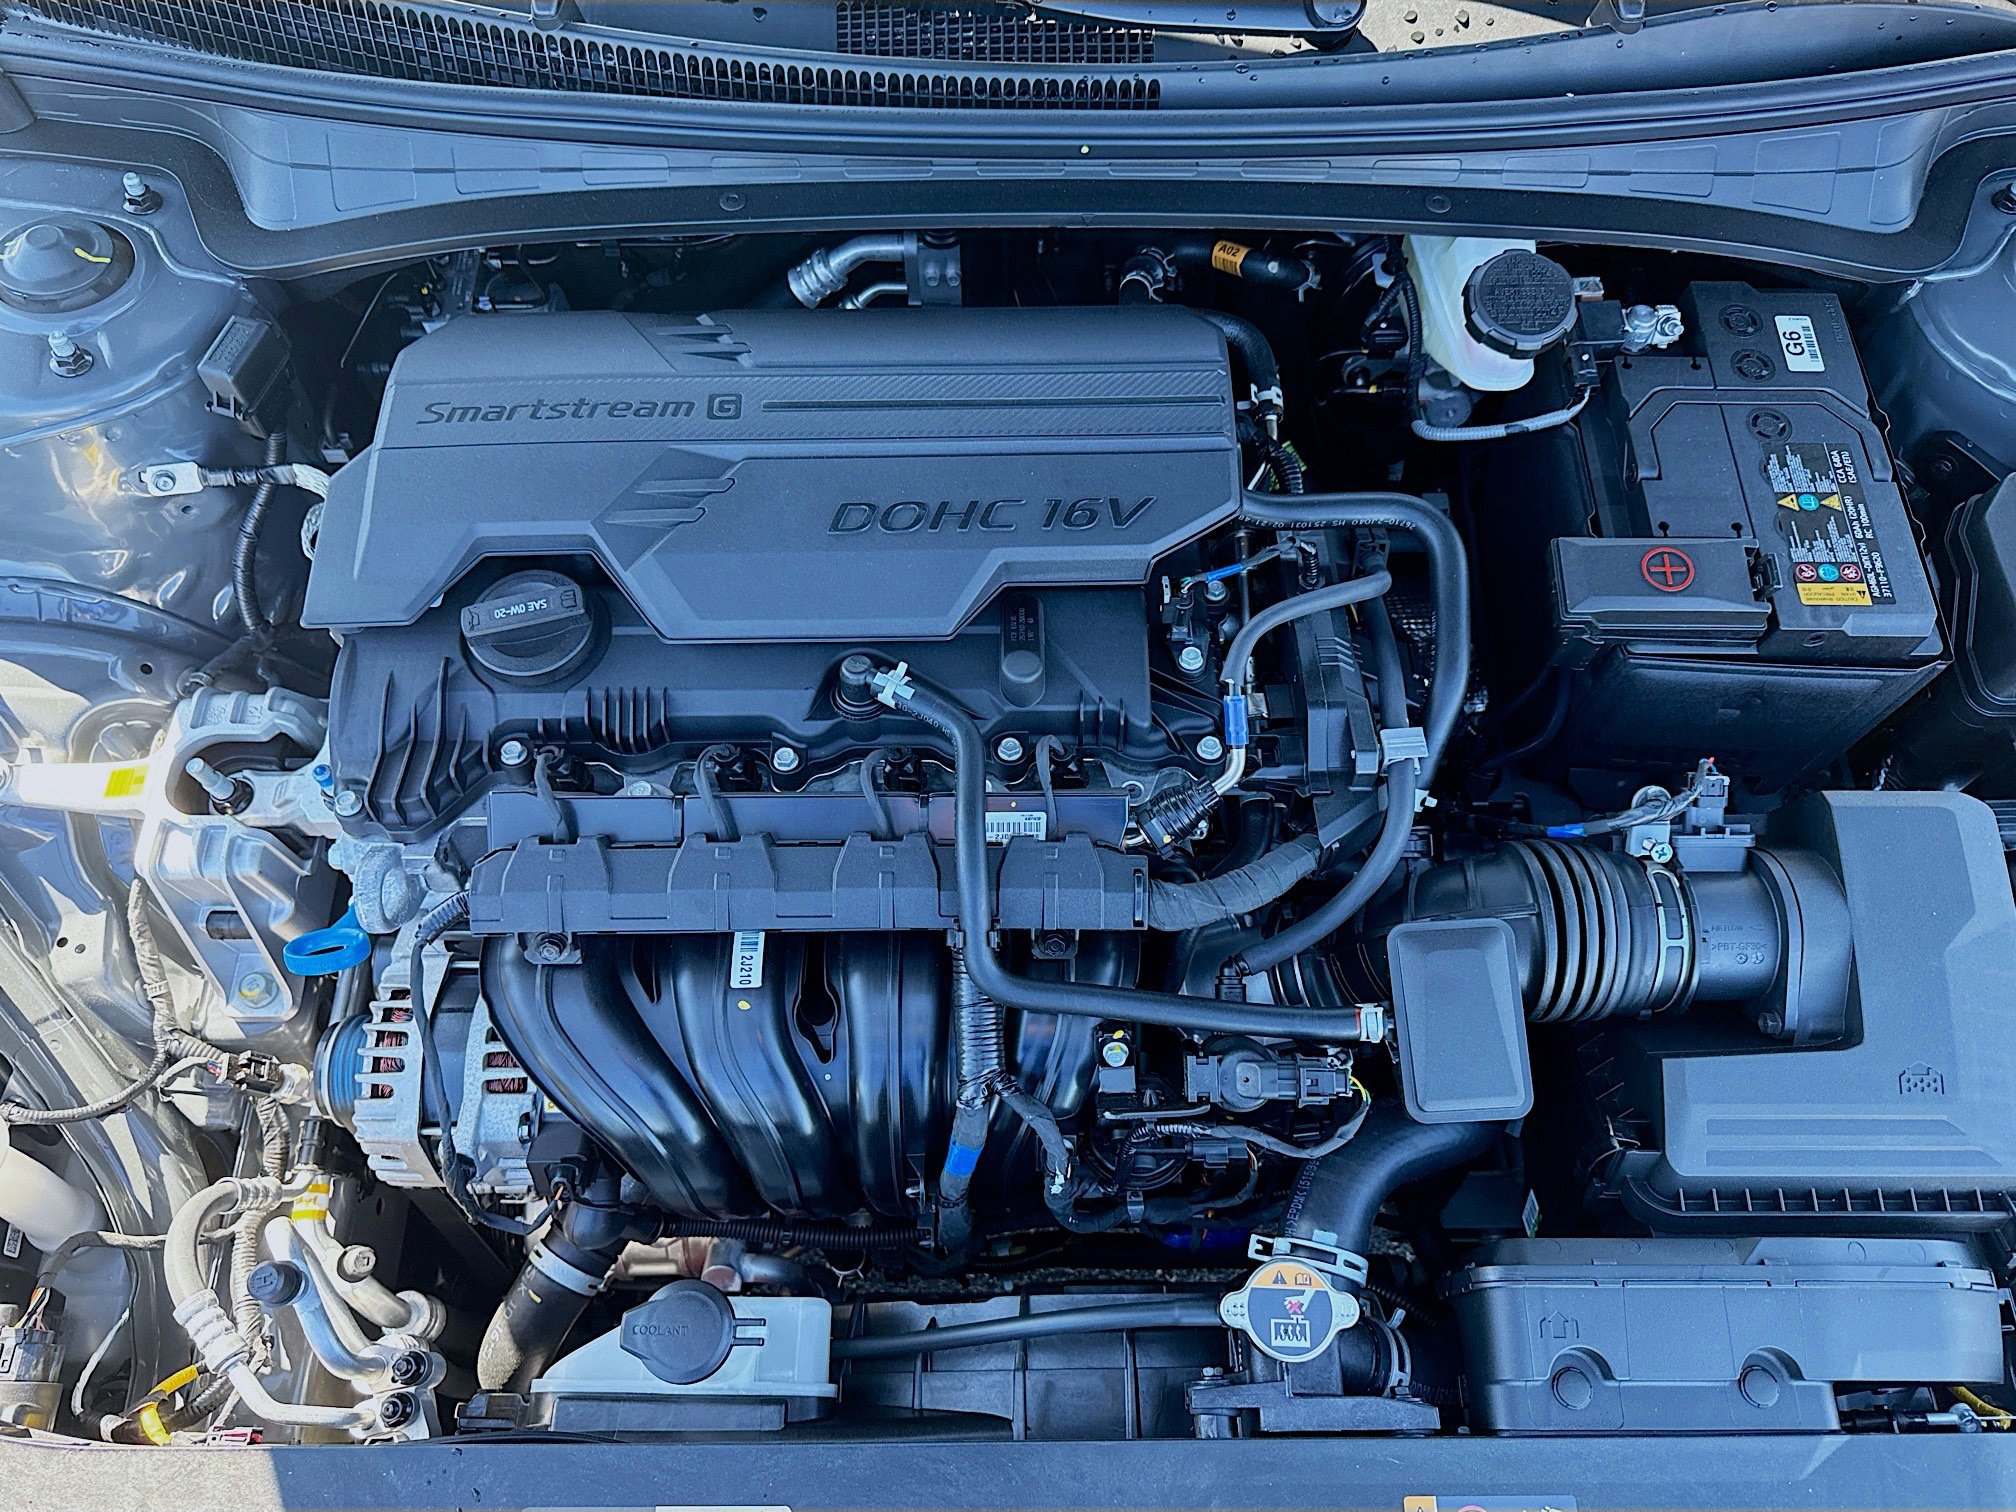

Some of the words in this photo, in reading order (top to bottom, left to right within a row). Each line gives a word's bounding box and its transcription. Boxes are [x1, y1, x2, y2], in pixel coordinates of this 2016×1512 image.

[1218, 245, 1240, 256] A02
[1783, 331, 1805, 356] G6
[416, 397, 696, 425] Smartstream
[1830, 450, 1843, 469] 640A
[1837, 468, 1847, 484] CCA
[827, 499, 1027, 534] DOHC
[1041, 496, 1157, 531] 16V
[1844, 496, 1857, 520] (20HR)
[1331, 519, 1345, 527] HS
[1865, 527, 1874, 539] RC
[494, 603, 526, 619] 0W-20
[527, 599, 548, 612] SAE
[895, 700, 939, 728] 30-2J040
[739, 955, 754, 985] 2J210
[632, 1324, 689, 1336] COOLANT
